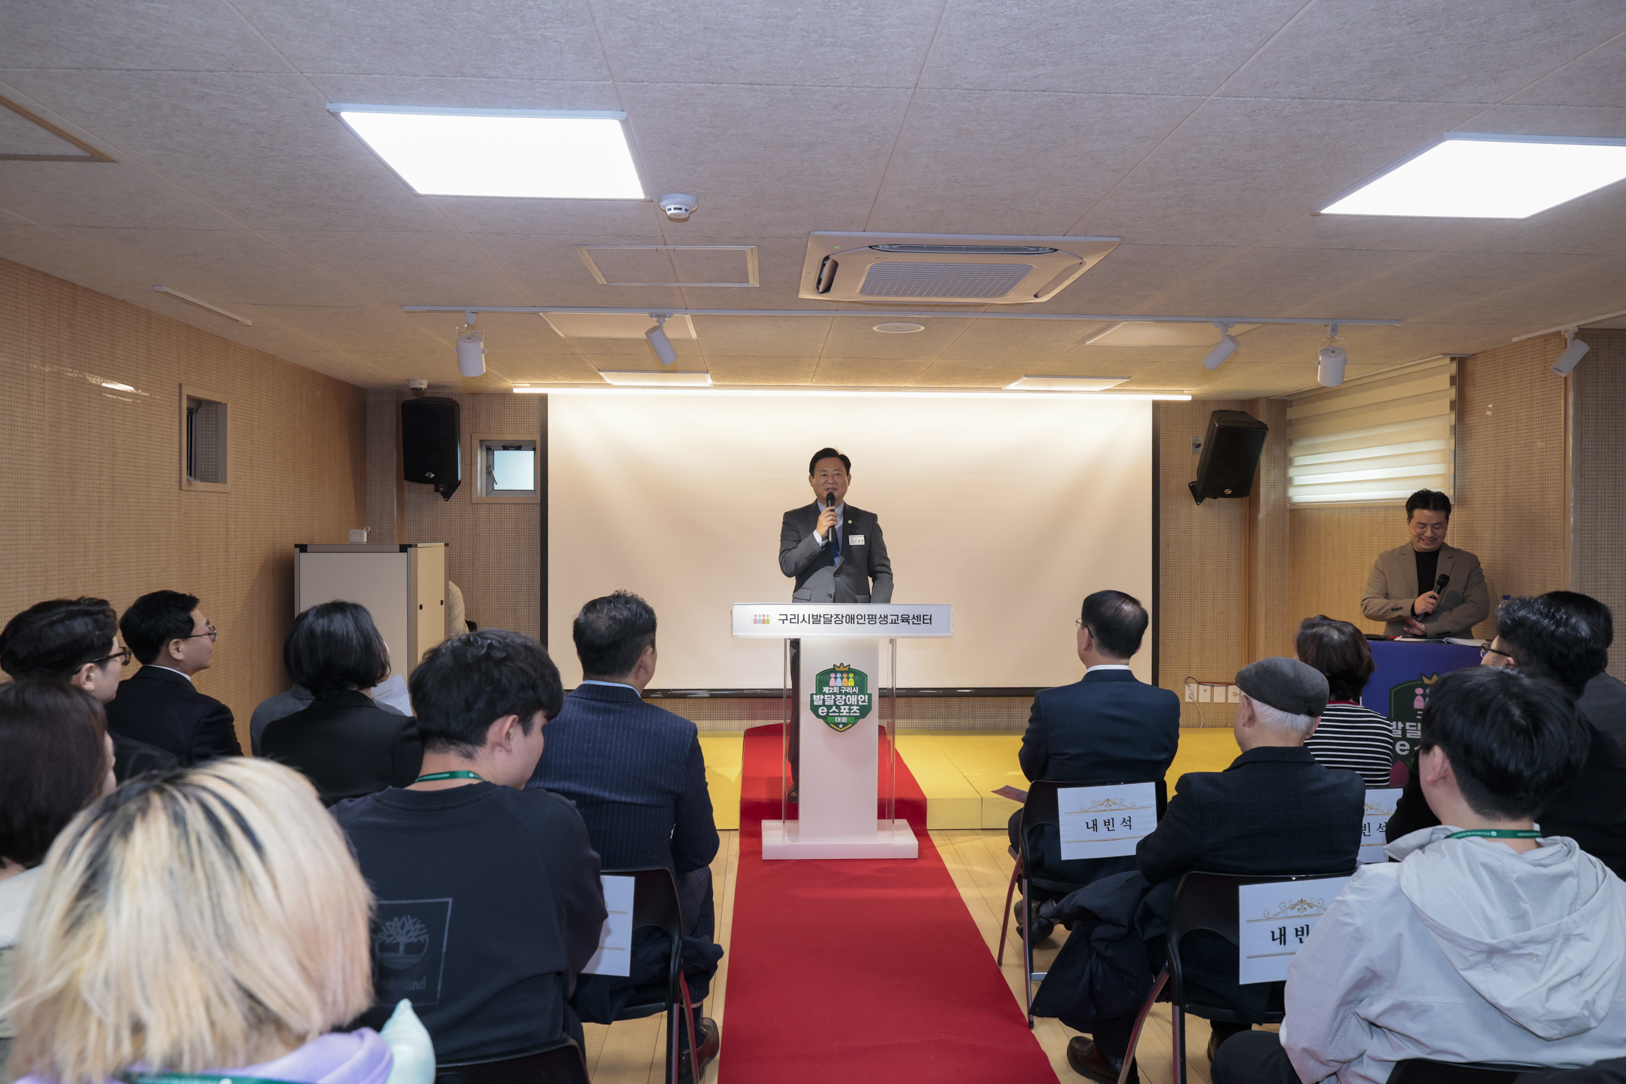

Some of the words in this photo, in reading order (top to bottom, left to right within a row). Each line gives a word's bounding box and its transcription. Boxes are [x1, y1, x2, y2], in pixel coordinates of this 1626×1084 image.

[778, 613, 933, 625] 구리시발달장애인평생교육센터
[822, 686, 839, 694] 제2회
[840, 686, 859, 694] 구리시
[813, 694, 869, 705] 발달장애인
[818, 705, 860, 716] e스포츠
[1270, 924, 1310, 946] 내빈
